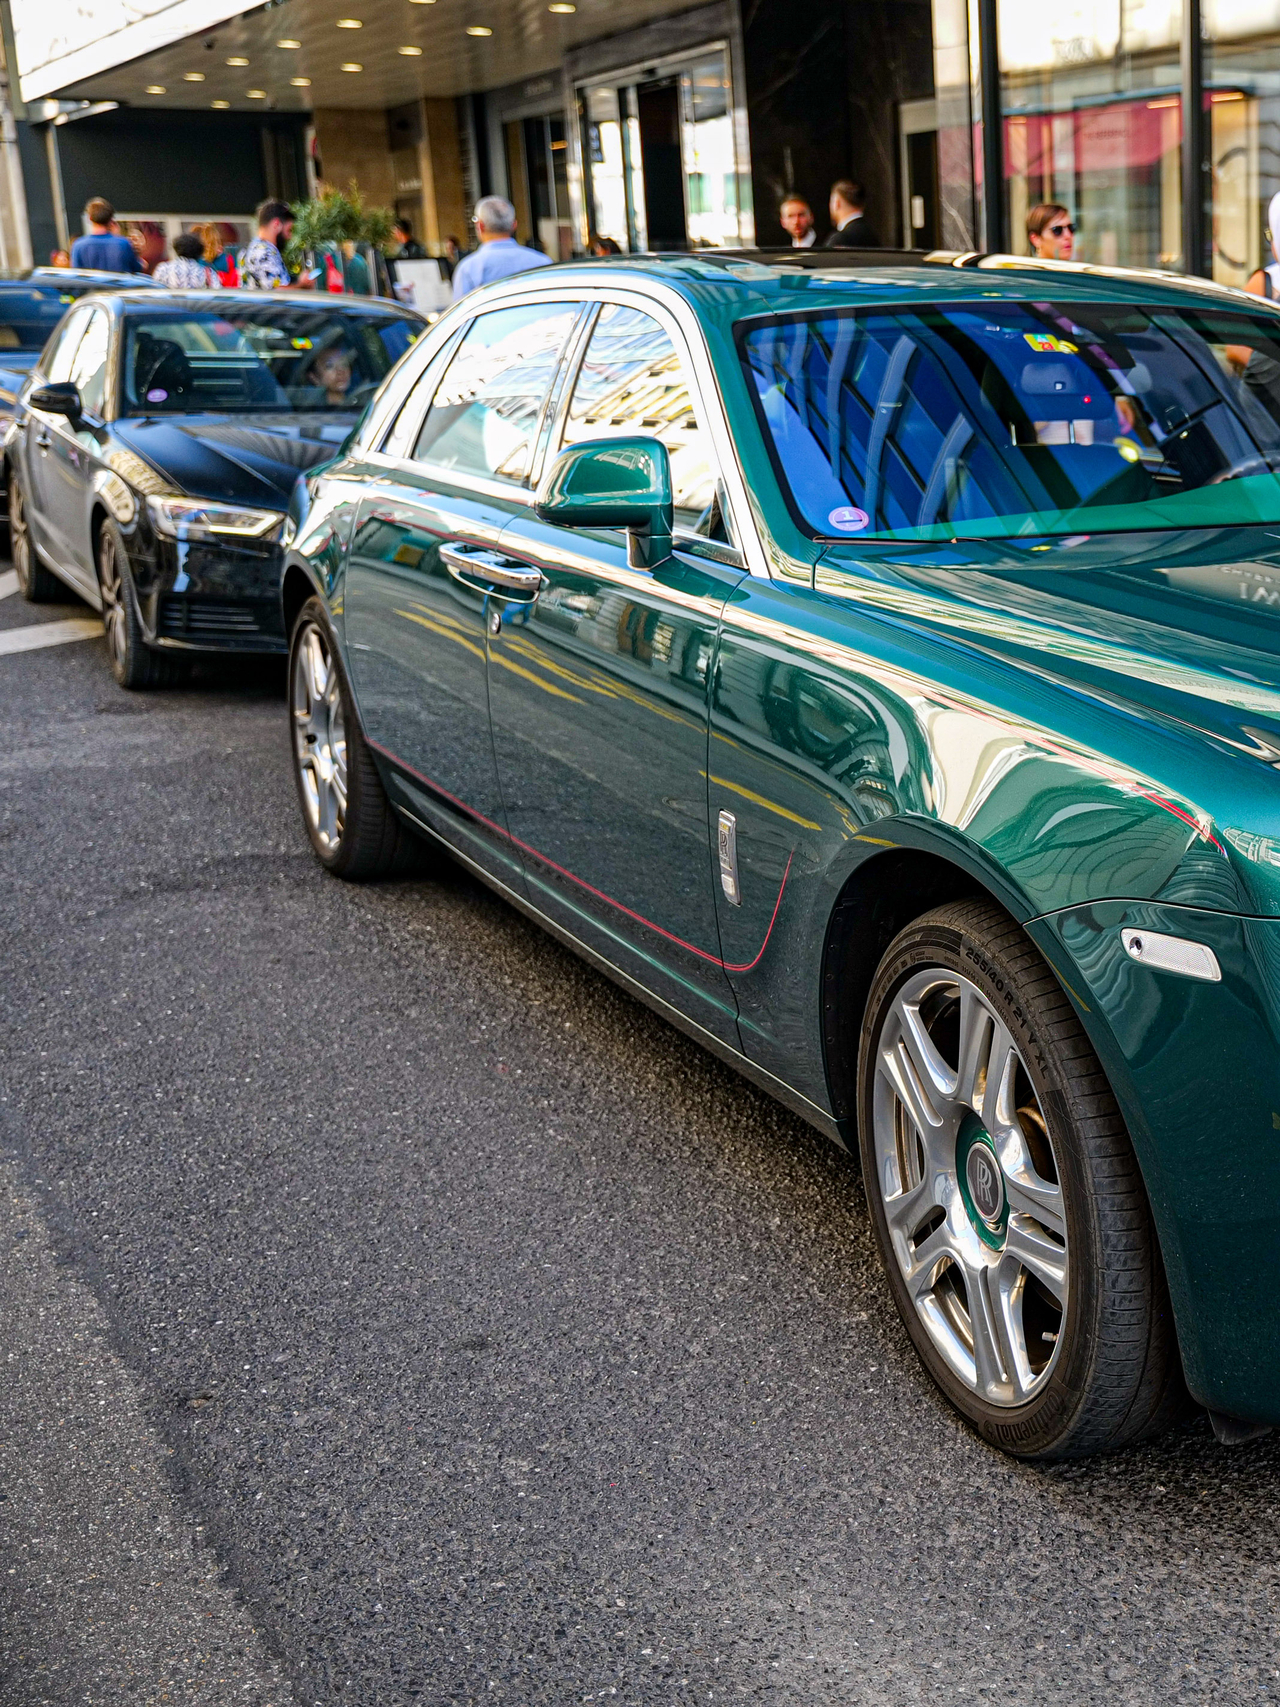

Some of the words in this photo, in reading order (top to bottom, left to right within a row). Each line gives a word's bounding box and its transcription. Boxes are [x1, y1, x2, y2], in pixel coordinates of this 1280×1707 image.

[841, 510, 854, 520] 1
[966, 947, 1004, 992] 255/40
[1004, 990, 1014, 1006] R
[1013, 1006, 1027, 1029] 21
[1034, 1051, 1050, 1080] XL
